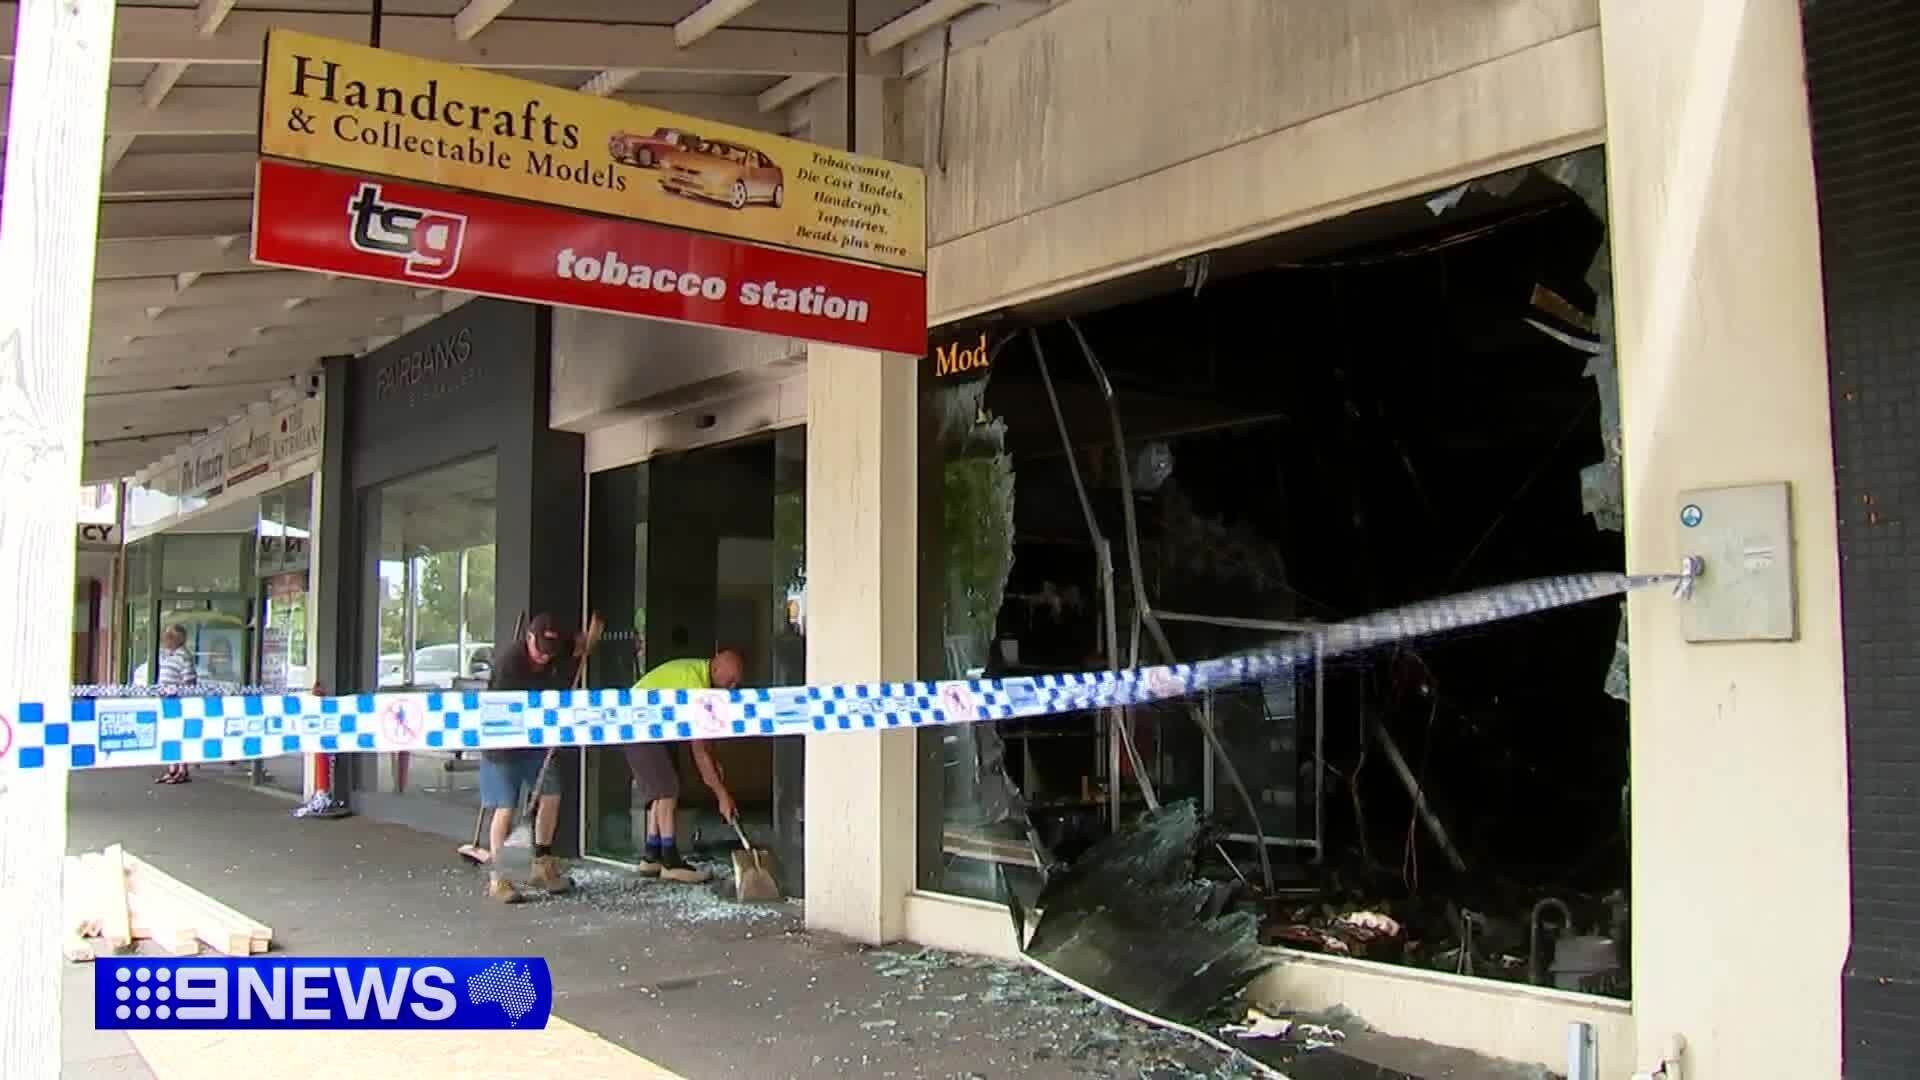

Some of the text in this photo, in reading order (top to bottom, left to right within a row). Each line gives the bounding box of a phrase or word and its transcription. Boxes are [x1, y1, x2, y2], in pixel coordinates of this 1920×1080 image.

[289, 55, 580, 150] Handcrafts
[287, 107, 627, 192] & Collectable Models
[796, 225, 838, 243] Beads
[556, 248, 869, 323] tobacco station
[935, 330, 990, 376] Mod
